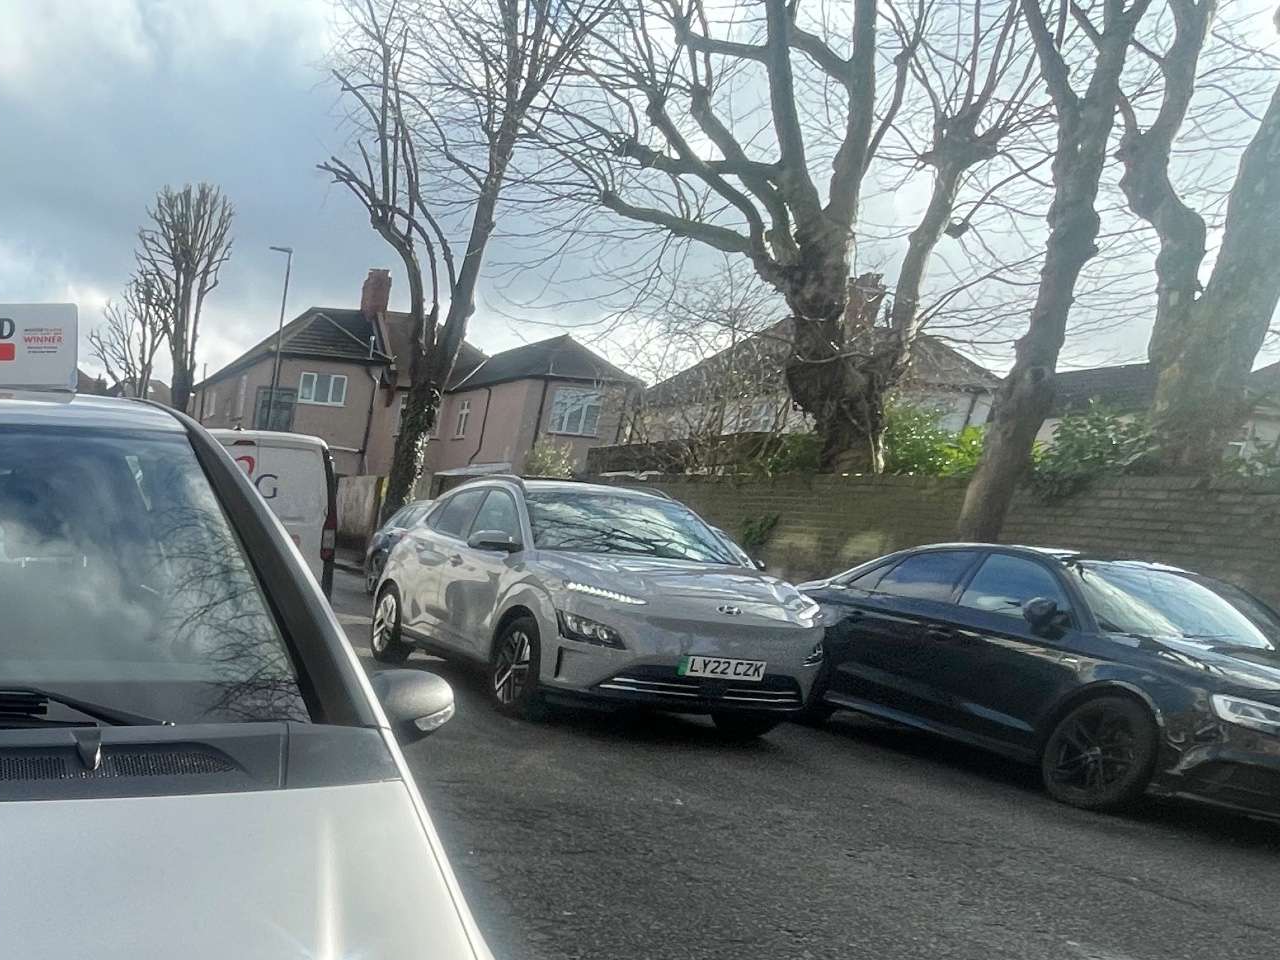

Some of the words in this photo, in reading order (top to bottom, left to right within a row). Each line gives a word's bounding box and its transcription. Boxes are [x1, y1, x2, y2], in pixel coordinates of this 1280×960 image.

[23, 335, 63, 344] WINNER
[689, 658, 731, 675] LY22
[733, 662, 764, 677] CZK
